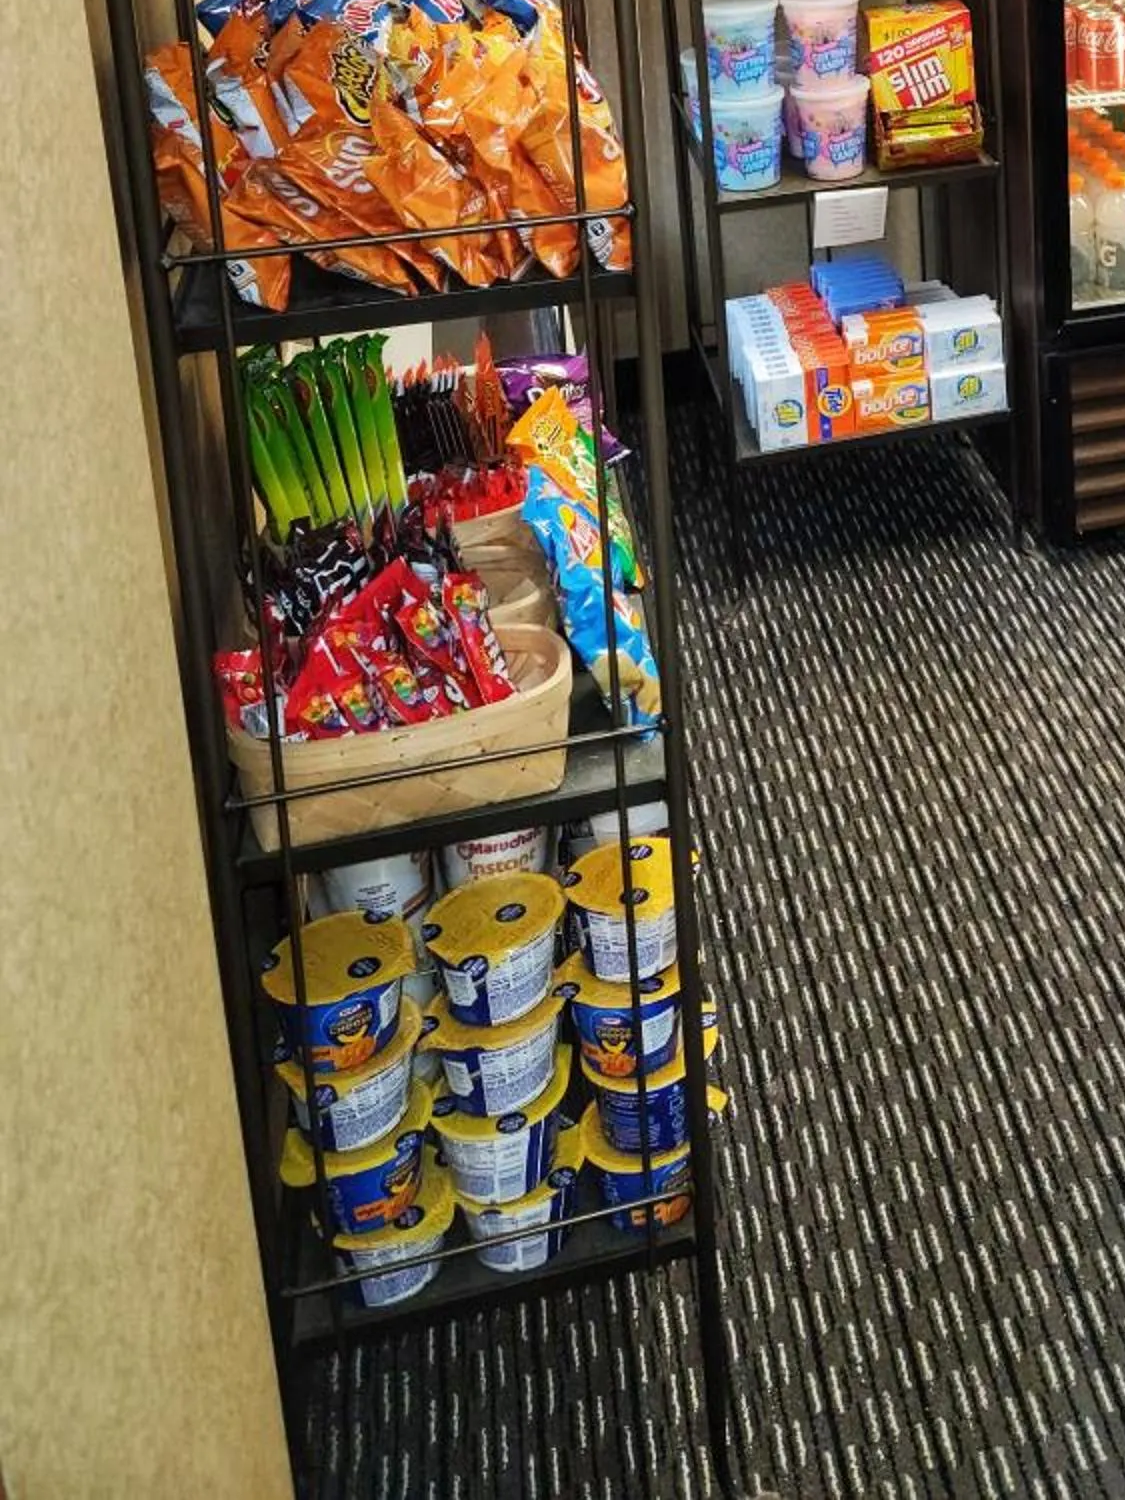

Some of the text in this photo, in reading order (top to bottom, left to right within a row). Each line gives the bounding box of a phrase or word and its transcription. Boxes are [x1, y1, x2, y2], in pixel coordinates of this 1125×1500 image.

[877, 45, 905, 67] 120
[1099, 242, 1117, 267] G
[527, 382, 588, 404] Dritos
